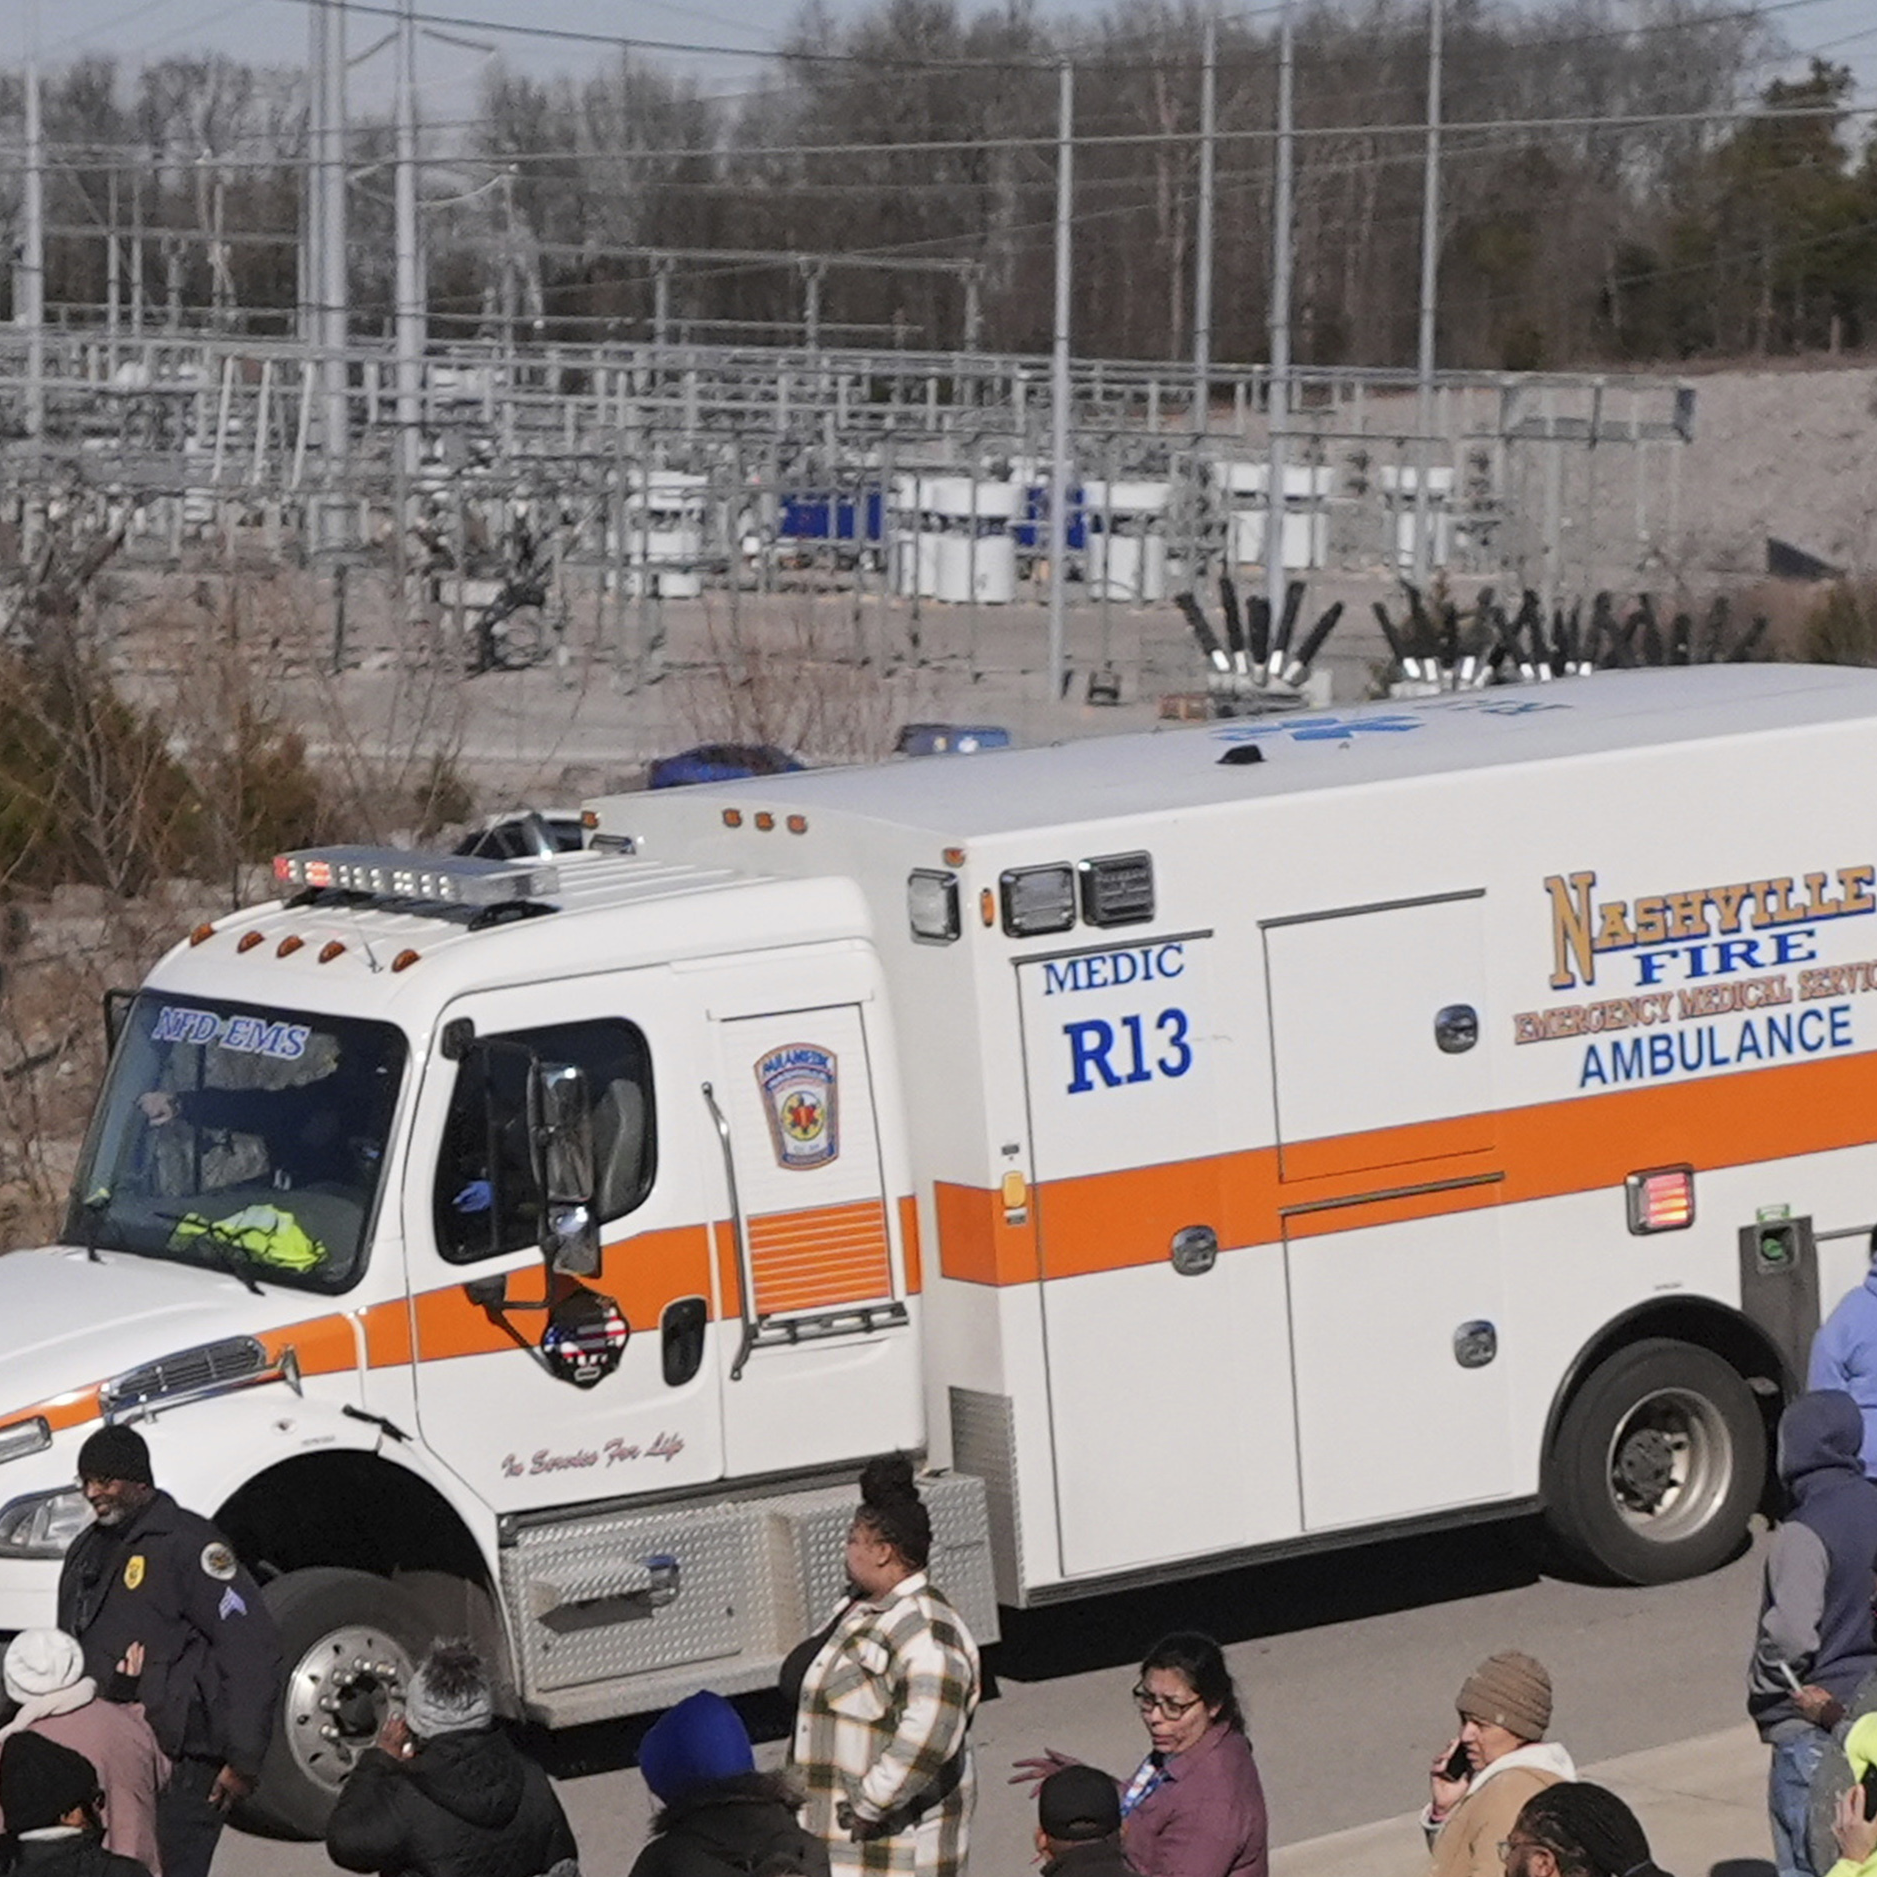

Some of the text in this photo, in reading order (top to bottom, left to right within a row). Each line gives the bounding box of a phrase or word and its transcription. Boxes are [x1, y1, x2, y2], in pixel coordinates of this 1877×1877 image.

[1544, 864, 1876, 990] NASHVILLE
[1634, 929, 1818, 987] FIRE
[1043, 943, 1185, 996] MEDIC
[152, 1006, 311, 1060] NFD EMS
[1513, 989, 1674, 1045] EMERGENCY
[1677, 973, 1792, 1021] MEDICAL
[1062, 1007, 1193, 1095] R13
[1578, 1004, 1853, 1088] AMBULANCE
